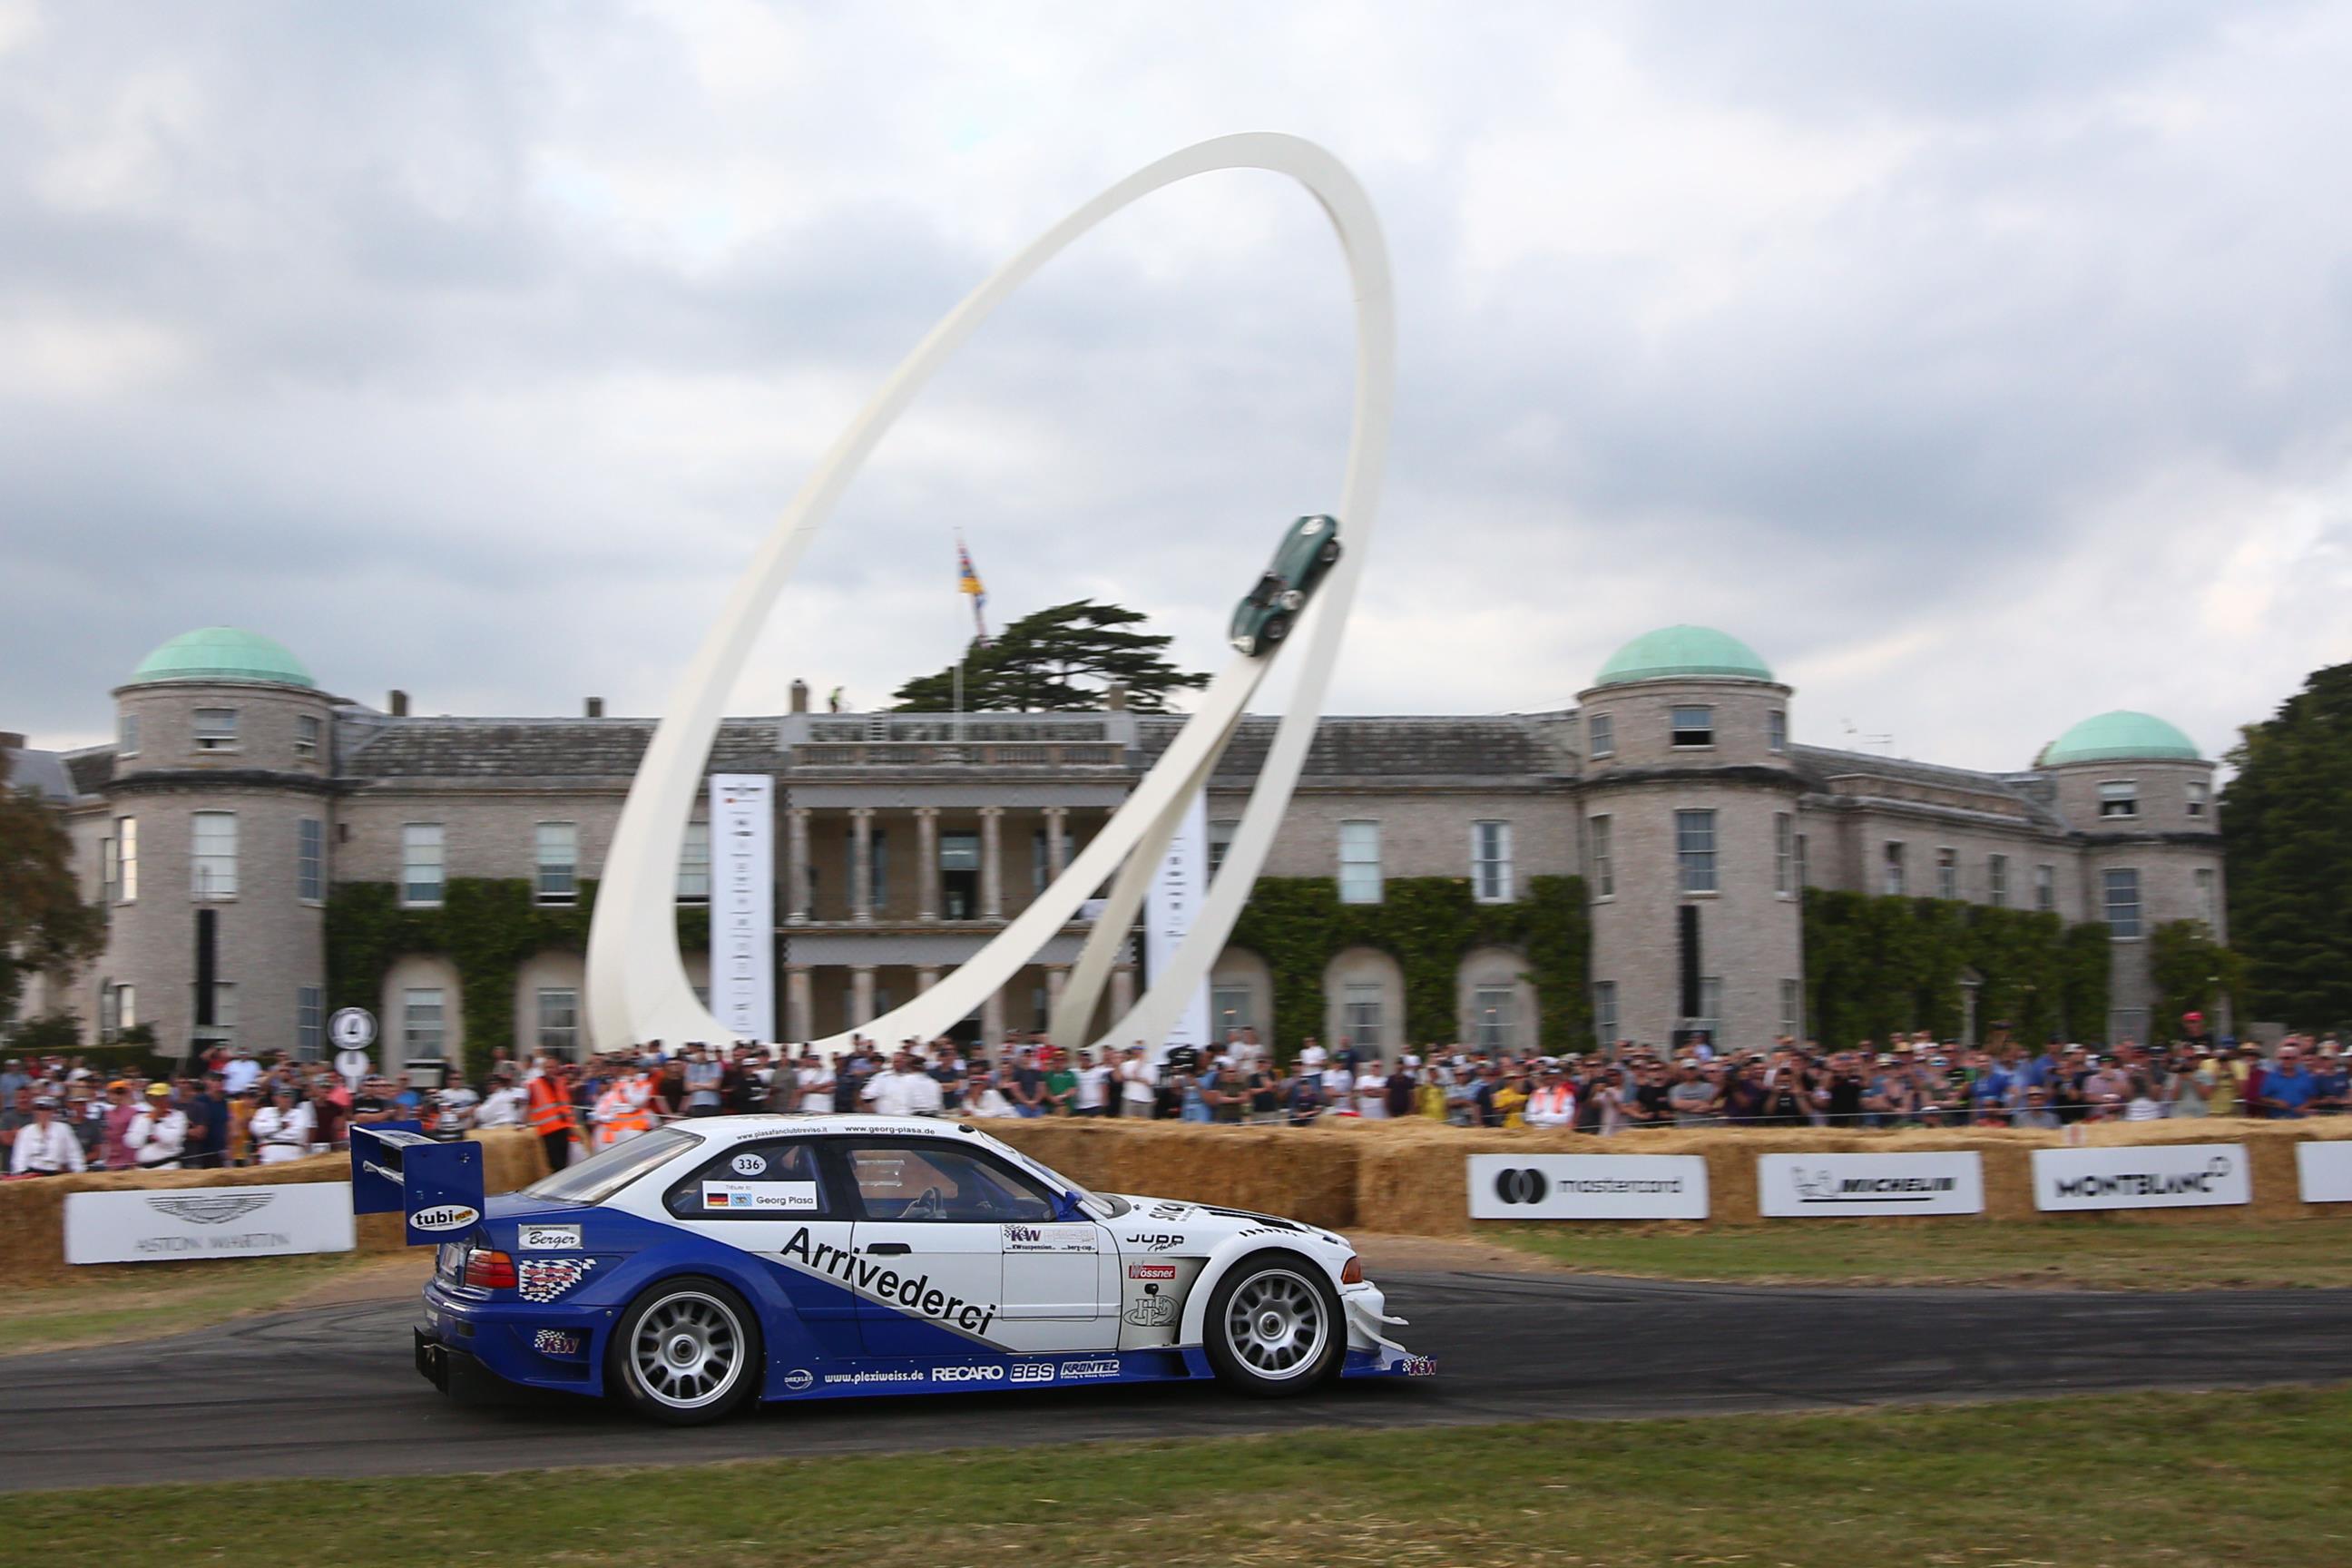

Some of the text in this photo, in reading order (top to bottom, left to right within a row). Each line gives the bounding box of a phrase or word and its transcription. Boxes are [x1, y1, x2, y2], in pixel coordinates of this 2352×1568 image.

[844, 1125, 936, 1135] www.georg-plasa.de
[739, 1159, 760, 1170] 336
[1840, 1177, 1958, 1193] MICHELIN
[2055, 1173, 2215, 1198] MONTBLANC
[756, 1196, 813, 1206] Georg Plasa
[416, 1210, 454, 1226] tubi
[529, 1230, 575, 1250] Berger
[1011, 1230, 1041, 1241] KW
[1126, 1234, 1184, 1244] JUDD
[780, 1226, 996, 1336] Arrivederci
[931, 1365, 1004, 1382] RECARO
[1009, 1363, 1055, 1382] BBS
[1061, 1359, 1120, 1375] KRONTEC
[824, 1370, 925, 1385] www.plexiweiss.de
